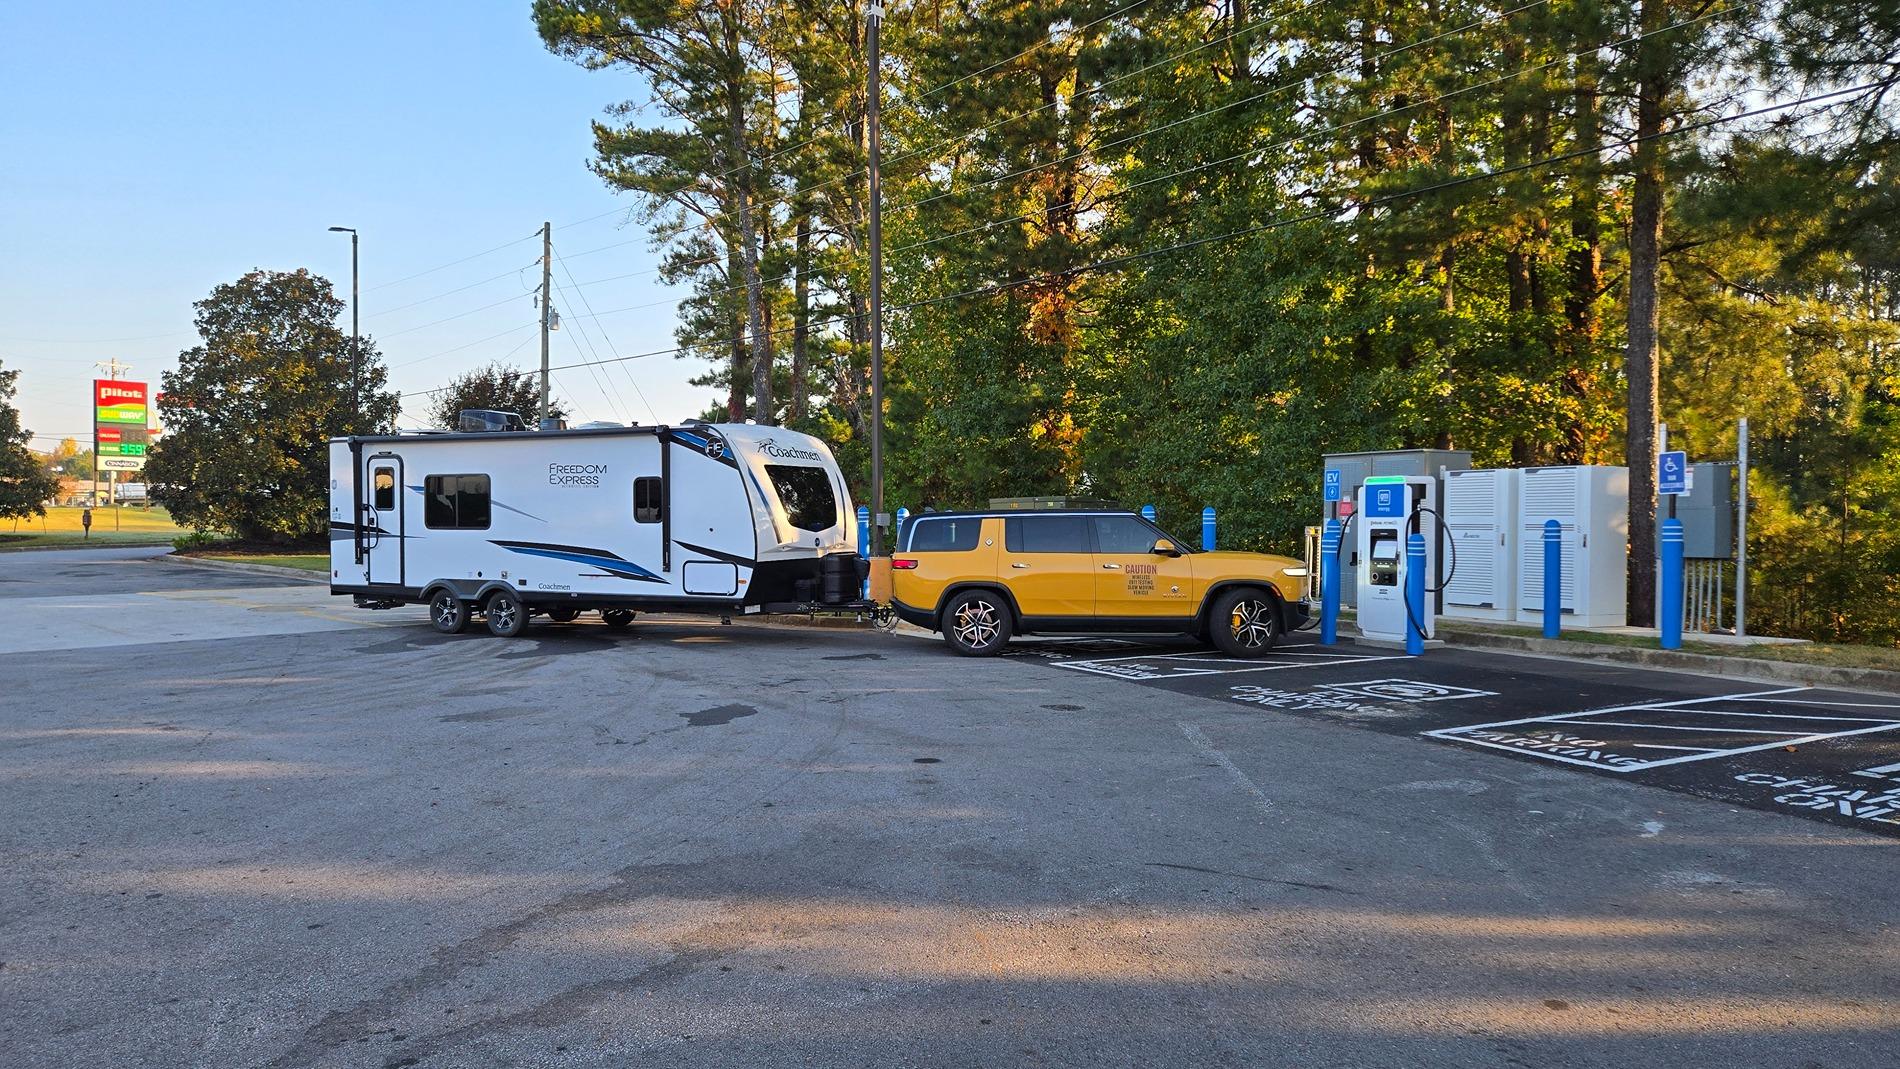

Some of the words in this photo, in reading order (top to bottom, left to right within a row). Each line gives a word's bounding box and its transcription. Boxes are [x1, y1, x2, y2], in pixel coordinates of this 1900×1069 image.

[102, 410, 144, 419] SUBWAY
[768, 446, 822, 461] Coachmen
[550, 463, 607, 474] FREEDOM
[550, 474, 599, 485] EXPRESS
[1327, 472, 1339, 483] EV
[1125, 564, 1157, 575] CAUTION
[538, 582, 571, 591] Coachmen
[1535, 733, 1607, 747] NO
[1460, 729, 1649, 766] PARKING
